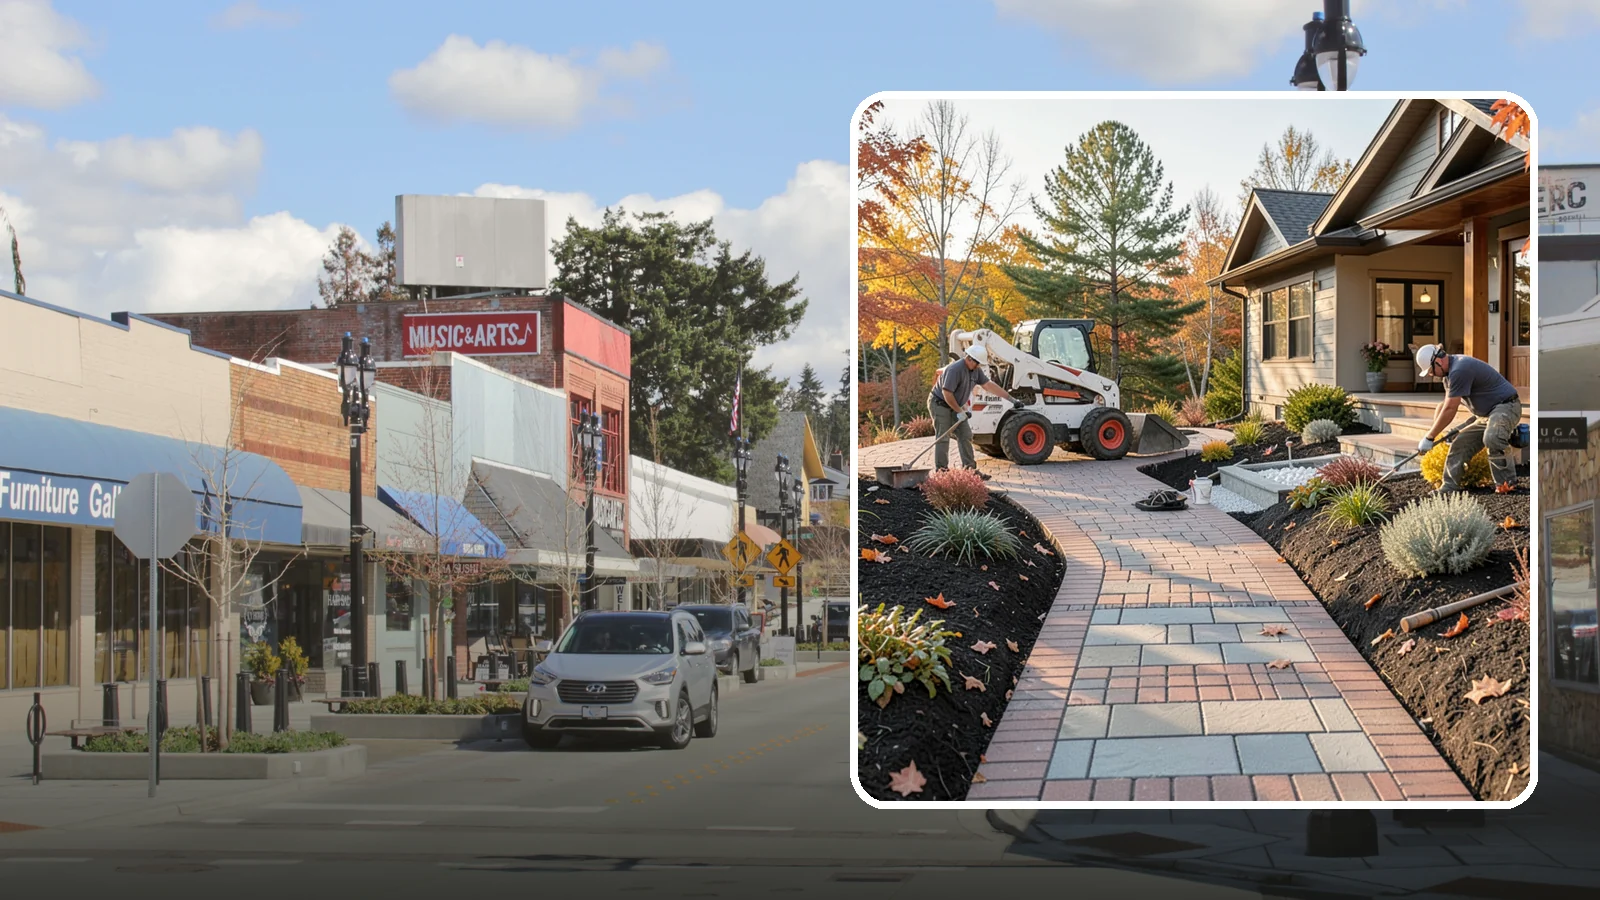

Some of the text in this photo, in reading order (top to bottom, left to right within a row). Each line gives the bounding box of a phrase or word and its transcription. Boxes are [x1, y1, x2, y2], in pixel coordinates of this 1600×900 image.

[408, 323, 520, 349] MUSIC&ARTS
[0, 471, 79, 516] Furniture
[453, 563, 480, 575] SUSHI
